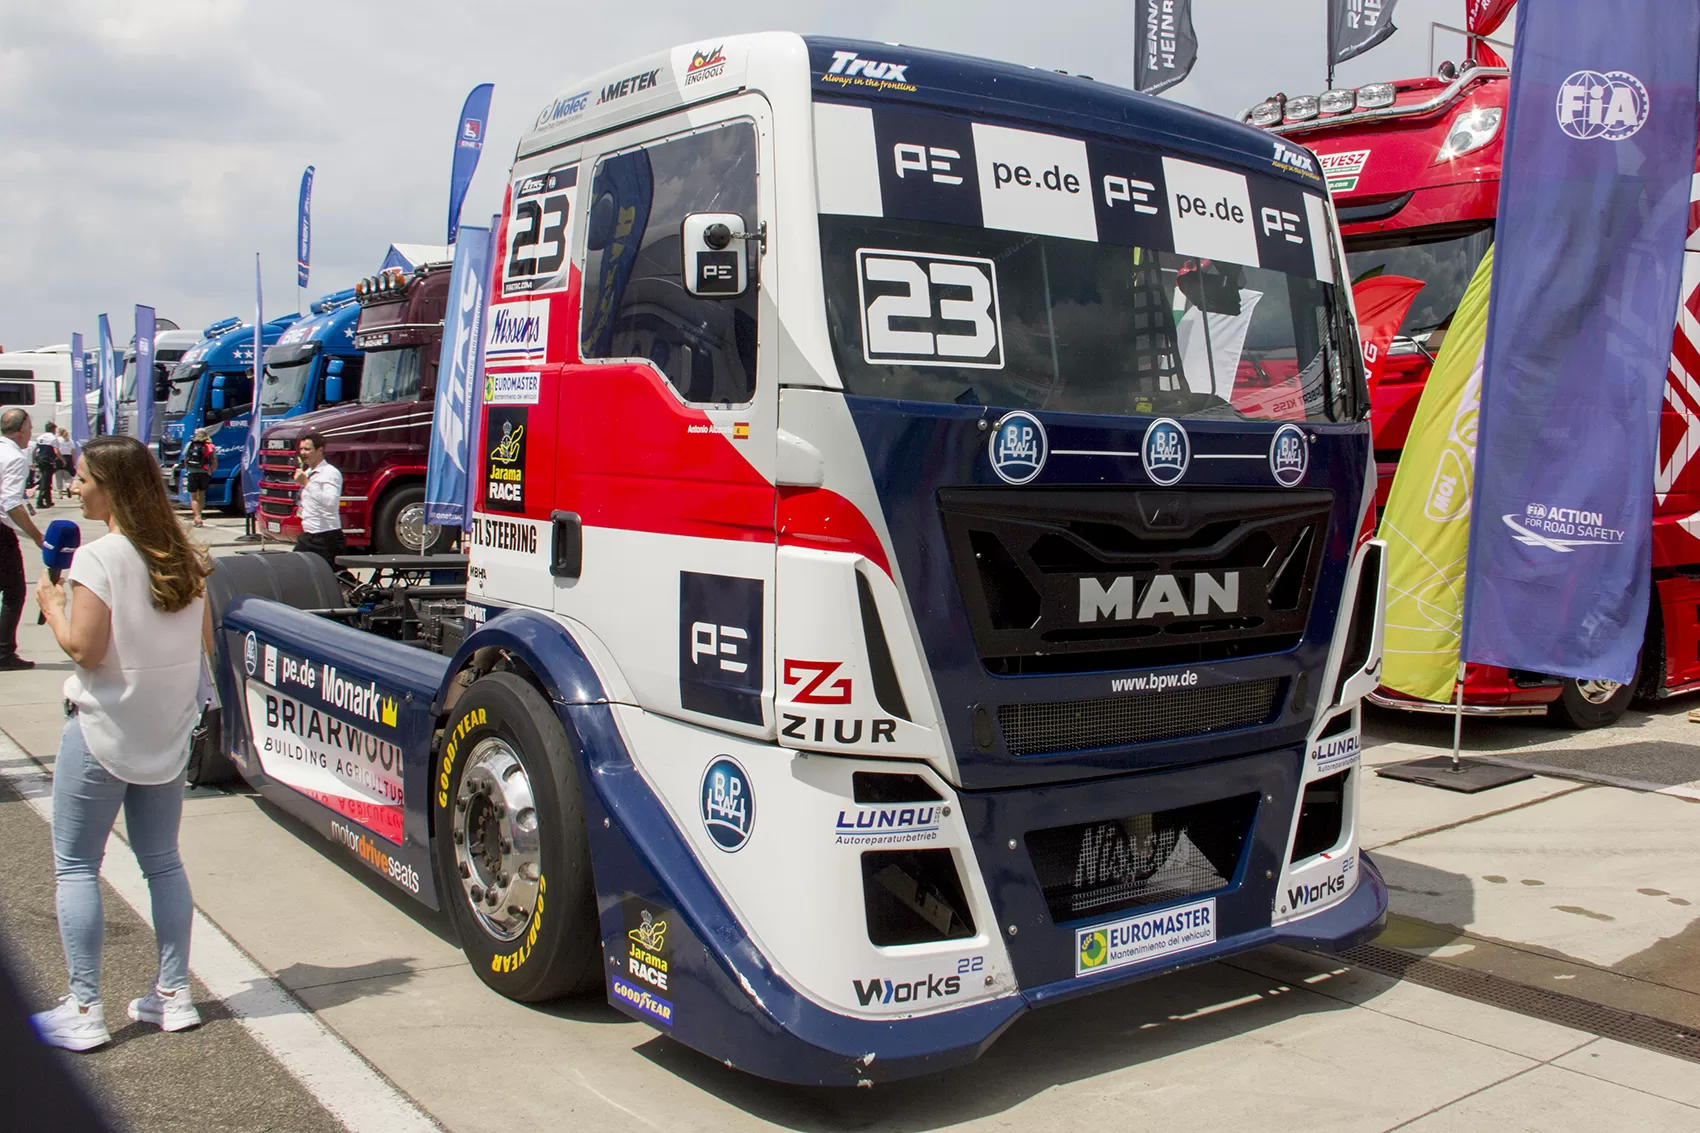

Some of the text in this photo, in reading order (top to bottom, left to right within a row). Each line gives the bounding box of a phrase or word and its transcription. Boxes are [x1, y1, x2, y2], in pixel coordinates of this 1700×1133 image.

[821, 73, 917, 92] Always in the frontline
[827, 50, 909, 82] Trux
[596, 68, 661, 106] AMETEK
[1273, 142, 1314, 172] Trux
[992, 160, 1081, 195] pe.de
[1175, 190, 1245, 225] pe.de
[508, 194, 571, 279] 23
[865, 256, 997, 358] 23
[491, 308, 540, 345] Nissens
[494, 376, 538, 391] EUROMASTER
[490, 464, 522, 482] Jarama
[489, 482, 522, 501] RACE
[1525, 517, 1625, 541] FOR ROAD SAFETY
[1548, 507, 1602, 527] ACTION
[485, 519, 537, 554] STEERING
[1078, 571, 1240, 623] MAN
[282, 654, 316, 689] pe.de
[1111, 670, 1199, 693] www.bpw.de
[321, 664, 381, 723] Monark
[782, 712, 897, 744] ZIUR
[264, 736, 328, 769] BUILDING
[439, 707, 488, 808] GOODYEAR
[836, 806, 934, 829] LUNAU
[835, 832, 938, 846] Autoreparaturbetrieb
[331, 818, 420, 894] motordriveseats
[1342, 856, 1355, 875] 22
[491, 873, 546, 974] GOODYEAR
[1110, 906, 1211, 949] EUROMASTER
[629, 943, 669, 973] Jarama
[1110, 940, 1167, 962] Mantenimiento
[1167, 933, 1180, 946] del
[629, 958, 669, 992] RACE
[957, 956, 984, 974] 22
[613, 981, 672, 1020] GOODYEAR
